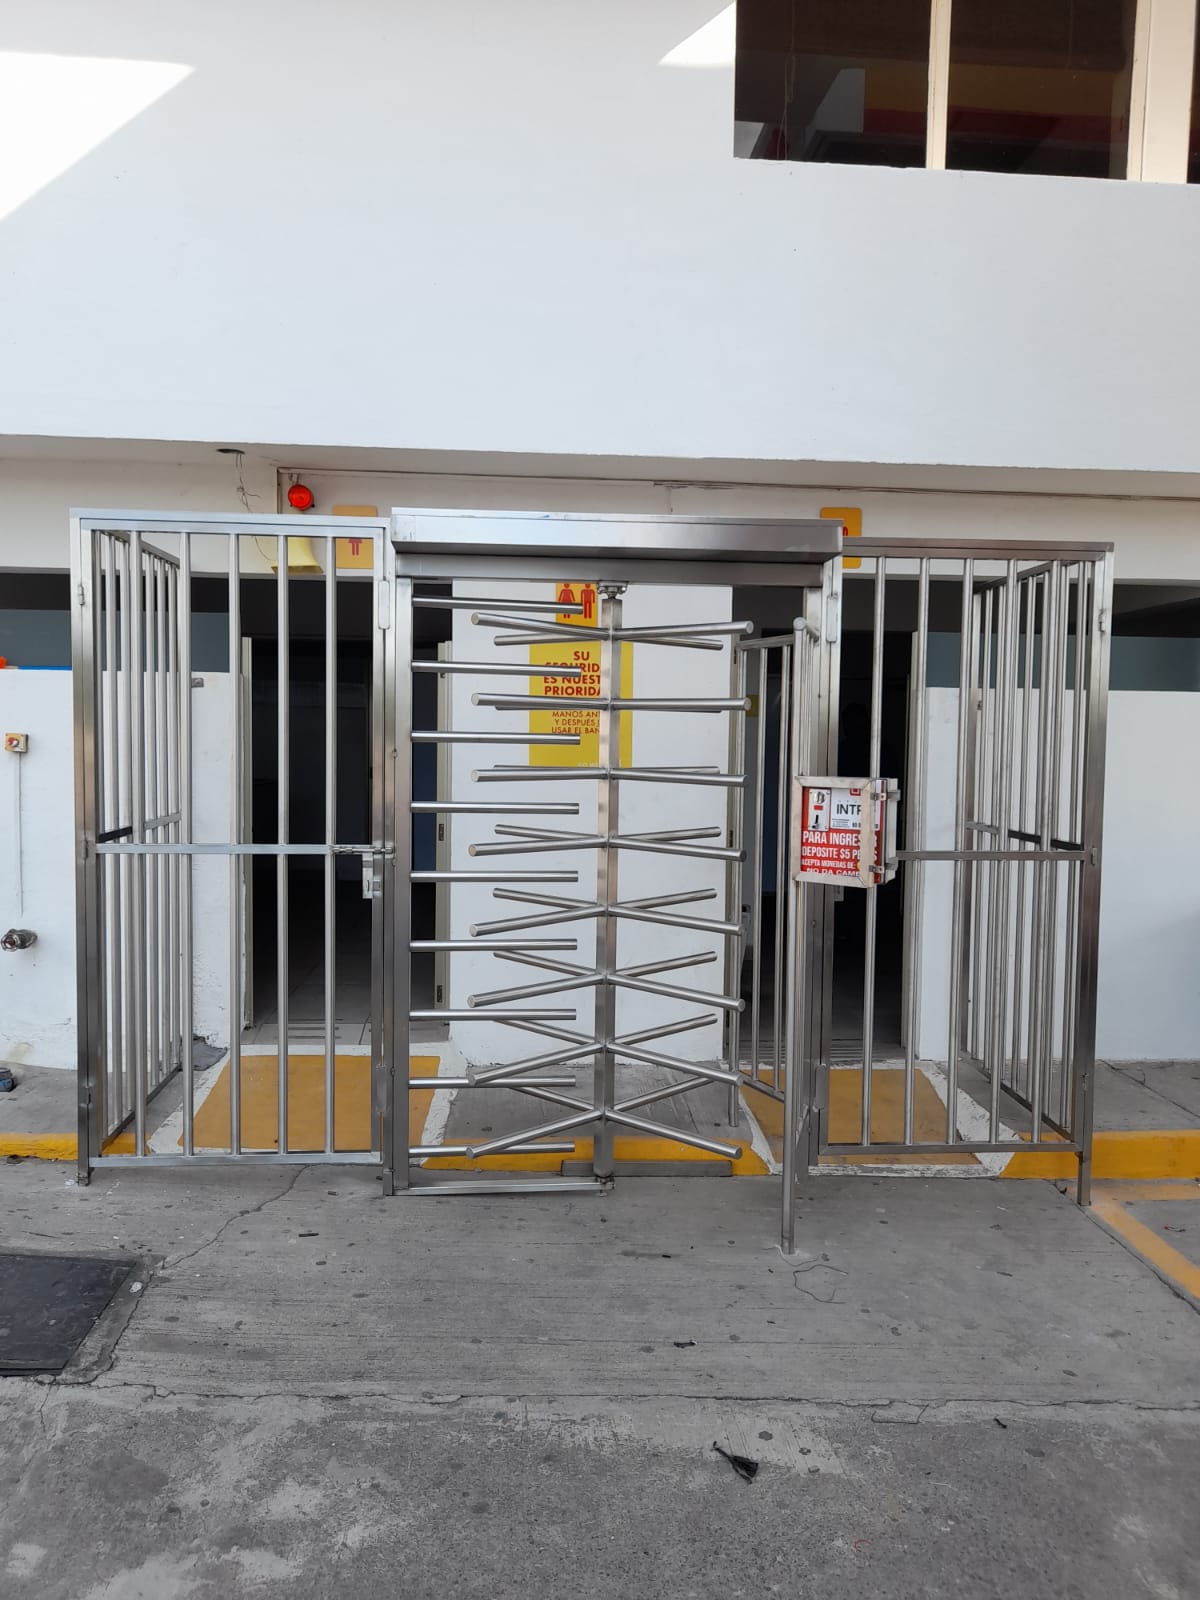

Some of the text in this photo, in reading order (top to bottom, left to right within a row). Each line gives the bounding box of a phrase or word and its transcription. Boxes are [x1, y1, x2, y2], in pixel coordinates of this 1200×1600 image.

[573, 651, 589, 660] SU
[544, 676, 557, 684] ES
[554, 718, 560, 726] Y
[803, 831, 826, 844] PARA
[802, 847, 838, 858] DEPOSITE
[840, 849, 850, 859] $5
